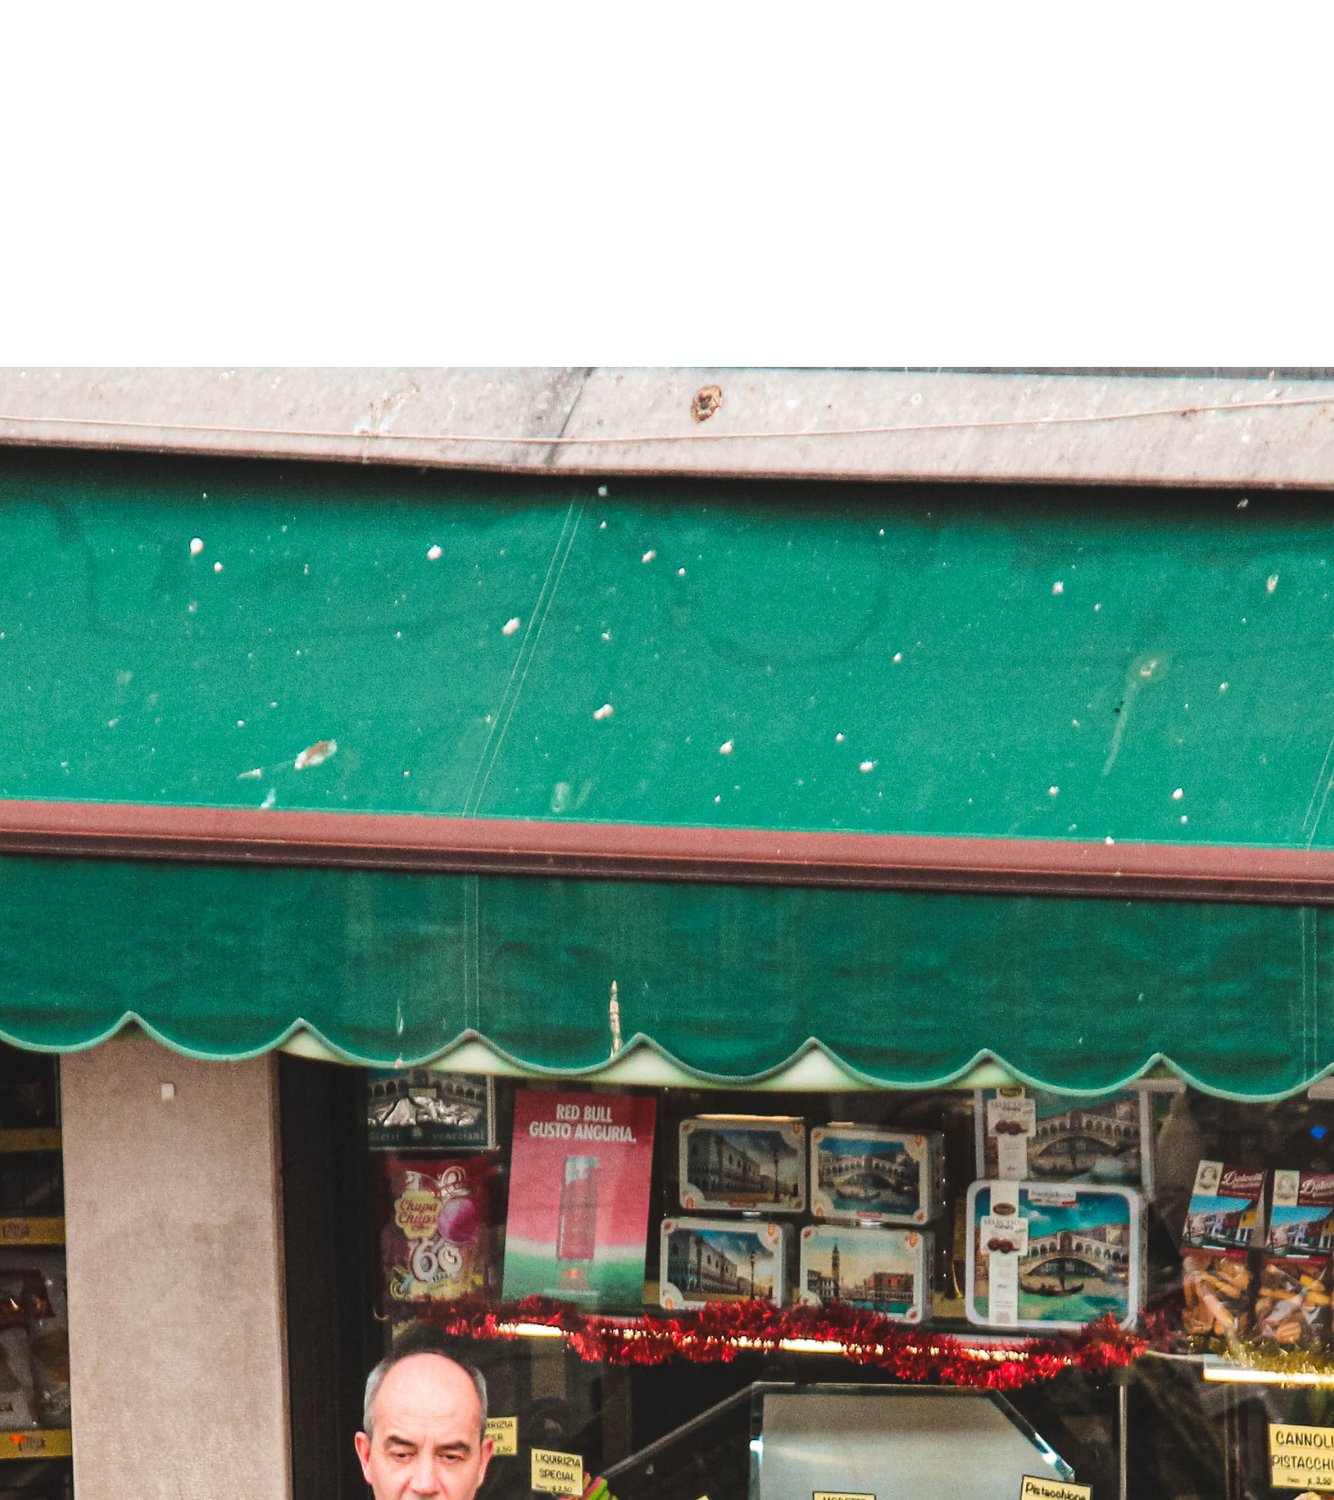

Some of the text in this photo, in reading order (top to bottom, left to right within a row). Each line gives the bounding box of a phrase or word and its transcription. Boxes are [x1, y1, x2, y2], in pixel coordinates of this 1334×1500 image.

[556, 1103, 613, 1123] RED BULL
[529, 1121, 637, 1143] GUSTO ANGURIA.
[1275, 1430, 1334, 1449] CANNOLI
[538, 1467, 577, 1482] SPECIAL
